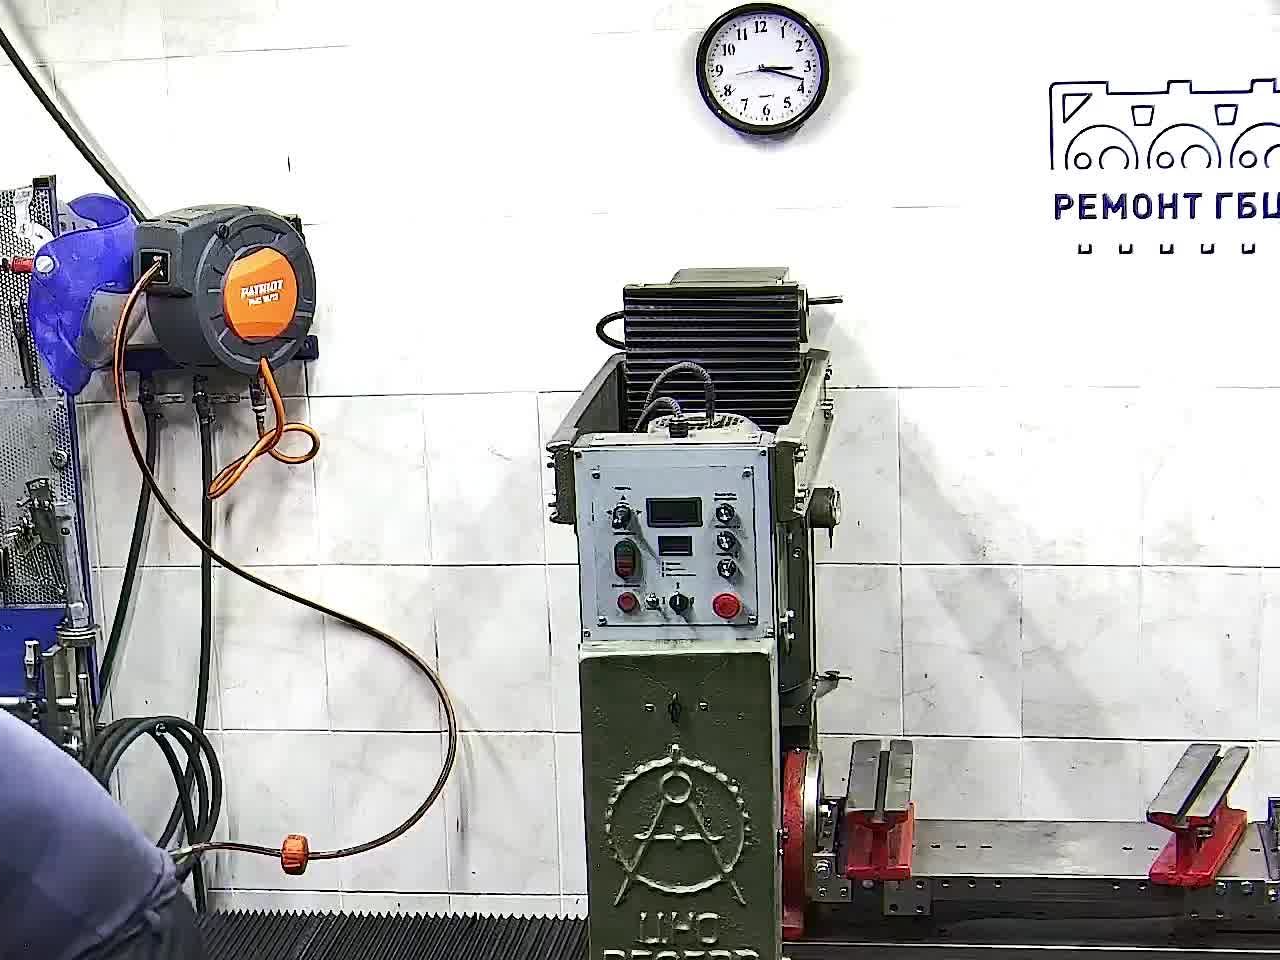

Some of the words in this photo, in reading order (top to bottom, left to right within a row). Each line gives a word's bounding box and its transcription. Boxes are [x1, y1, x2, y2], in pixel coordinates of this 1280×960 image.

[755, 21, 768, 33] 12
[737, 28, 748, 40] 11
[723, 43, 736, 56] 10
[795, 40, 804, 52] 2
[715, 64, 724, 77] 9
[804, 60, 812, 73] 3
[723, 84, 732, 97] 8
[796, 81, 805, 94] 4
[741, 98, 748, 111] 7
[783, 96, 792, 109] 5
[762, 104, 771, 117] 6
[1054, 192, 1203, 221] РЕМОНТ
[241, 279, 284, 298] PATRIOT
